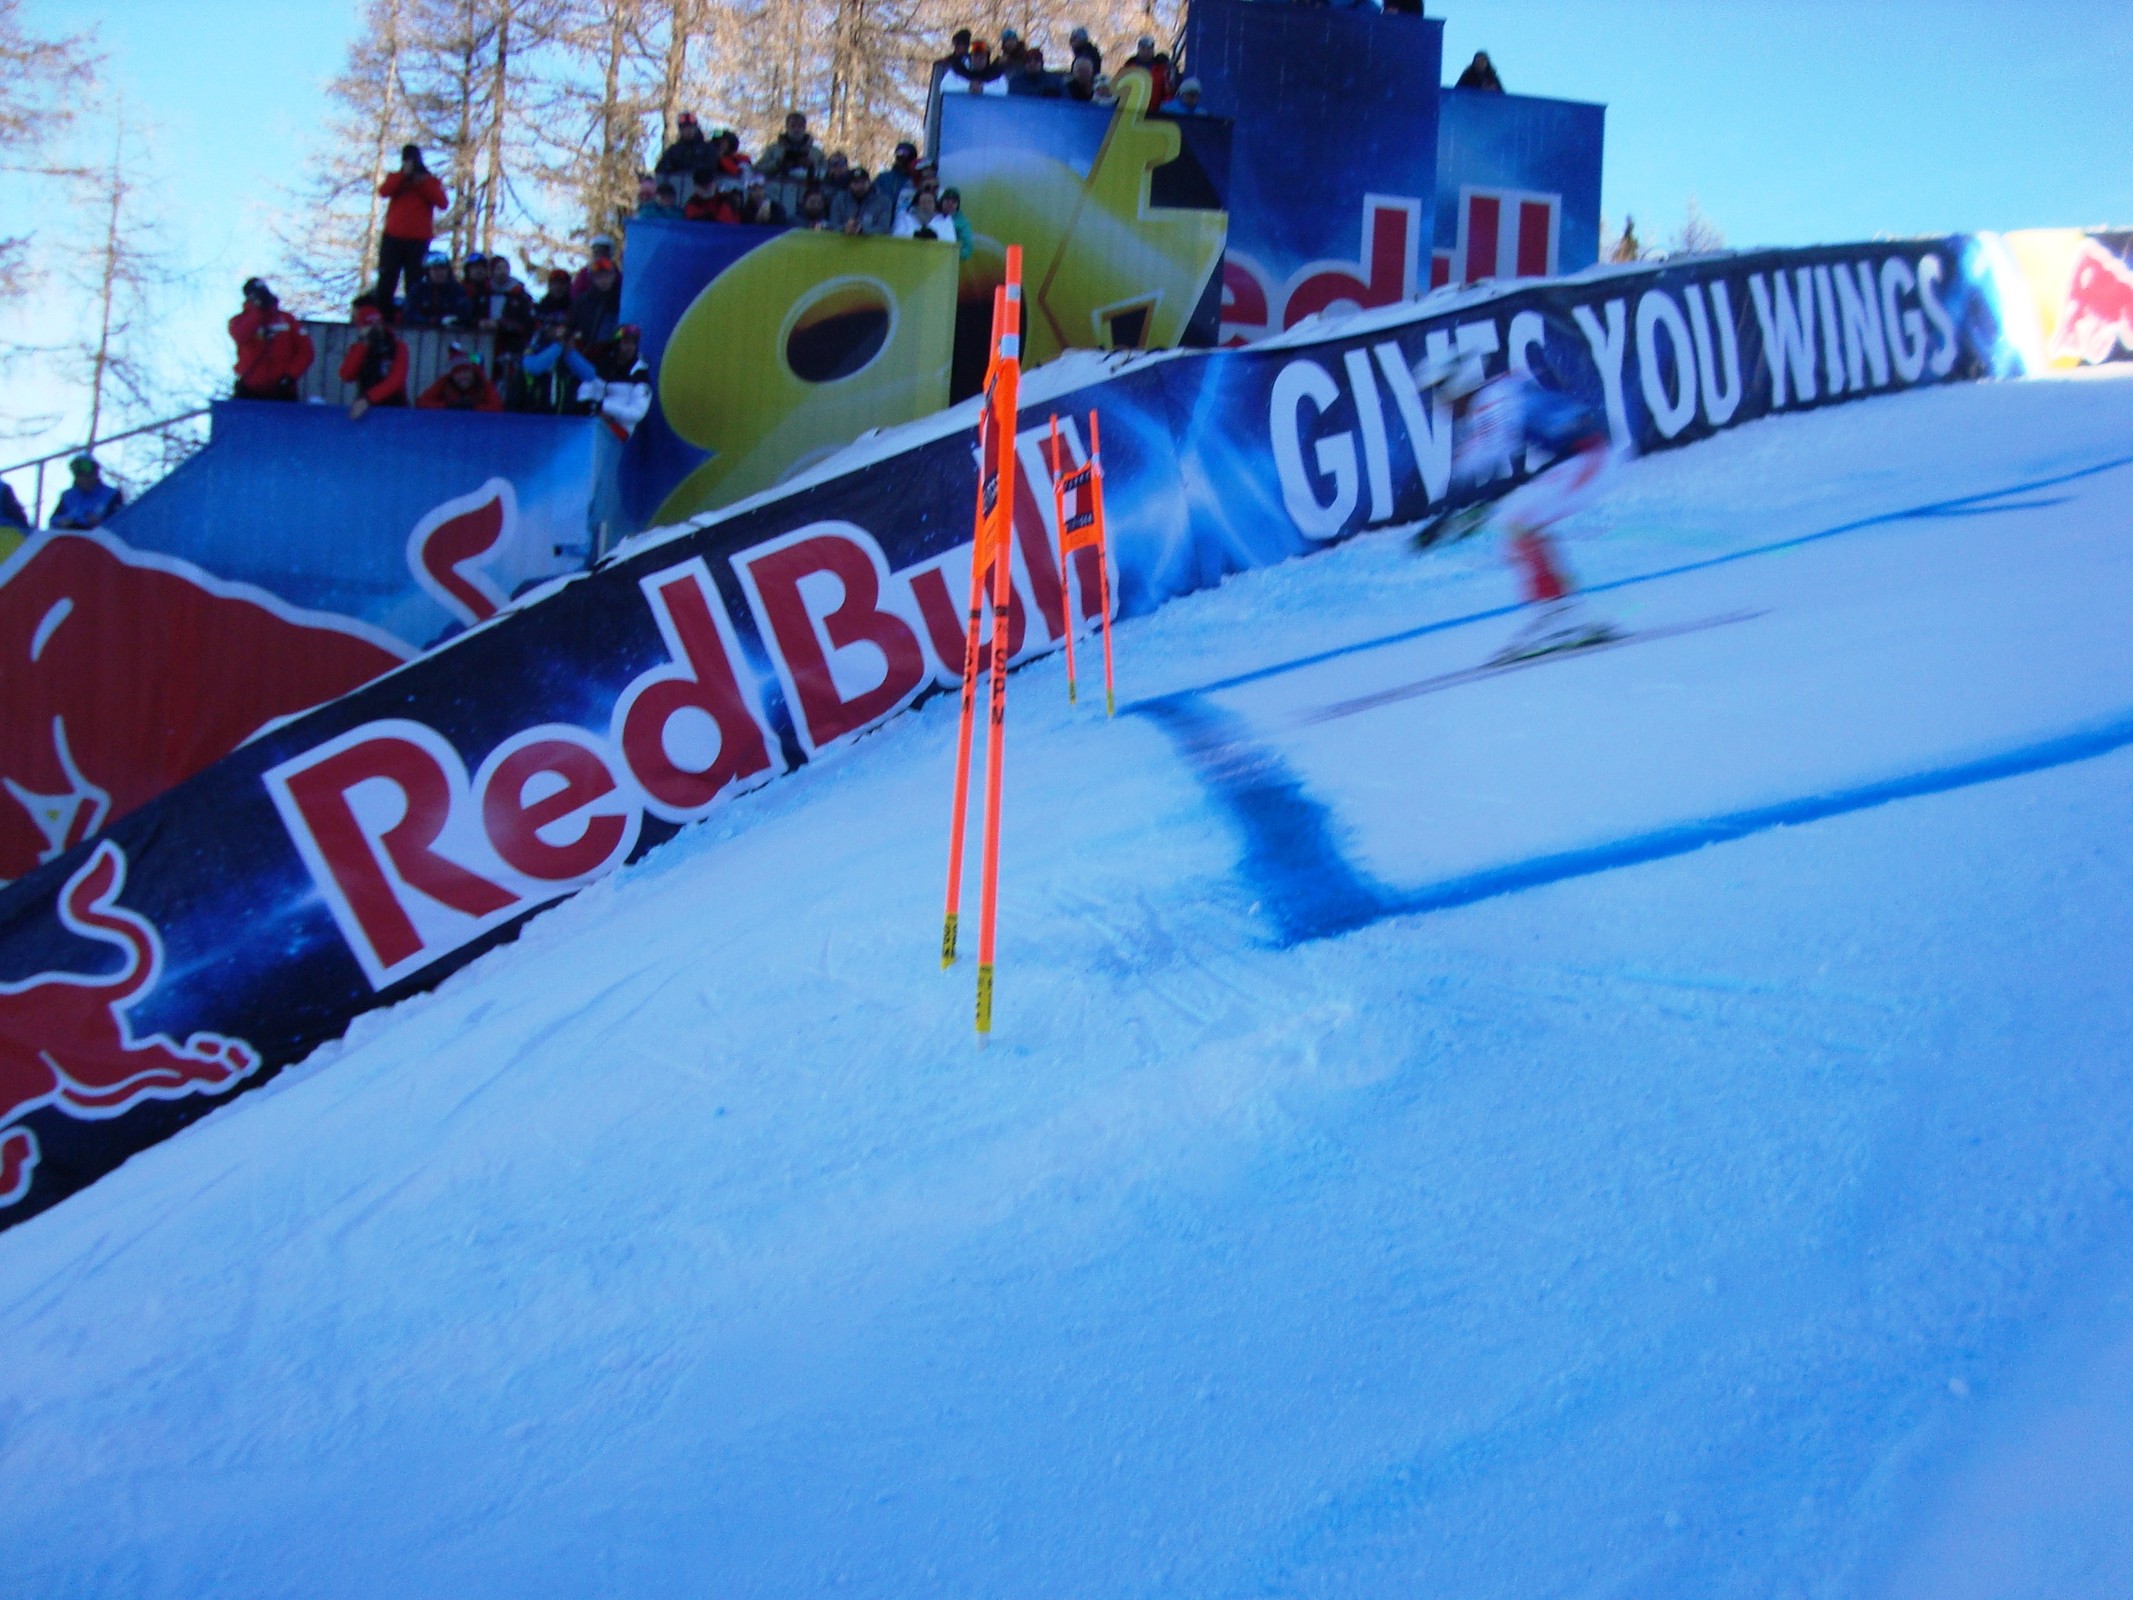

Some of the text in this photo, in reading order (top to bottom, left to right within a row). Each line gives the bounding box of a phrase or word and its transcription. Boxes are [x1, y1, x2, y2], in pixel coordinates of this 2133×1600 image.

[1572, 277, 1741, 460] YOU
[1750, 253, 1959, 409] WINGS
[262, 416, 1120, 992] Red Bull
